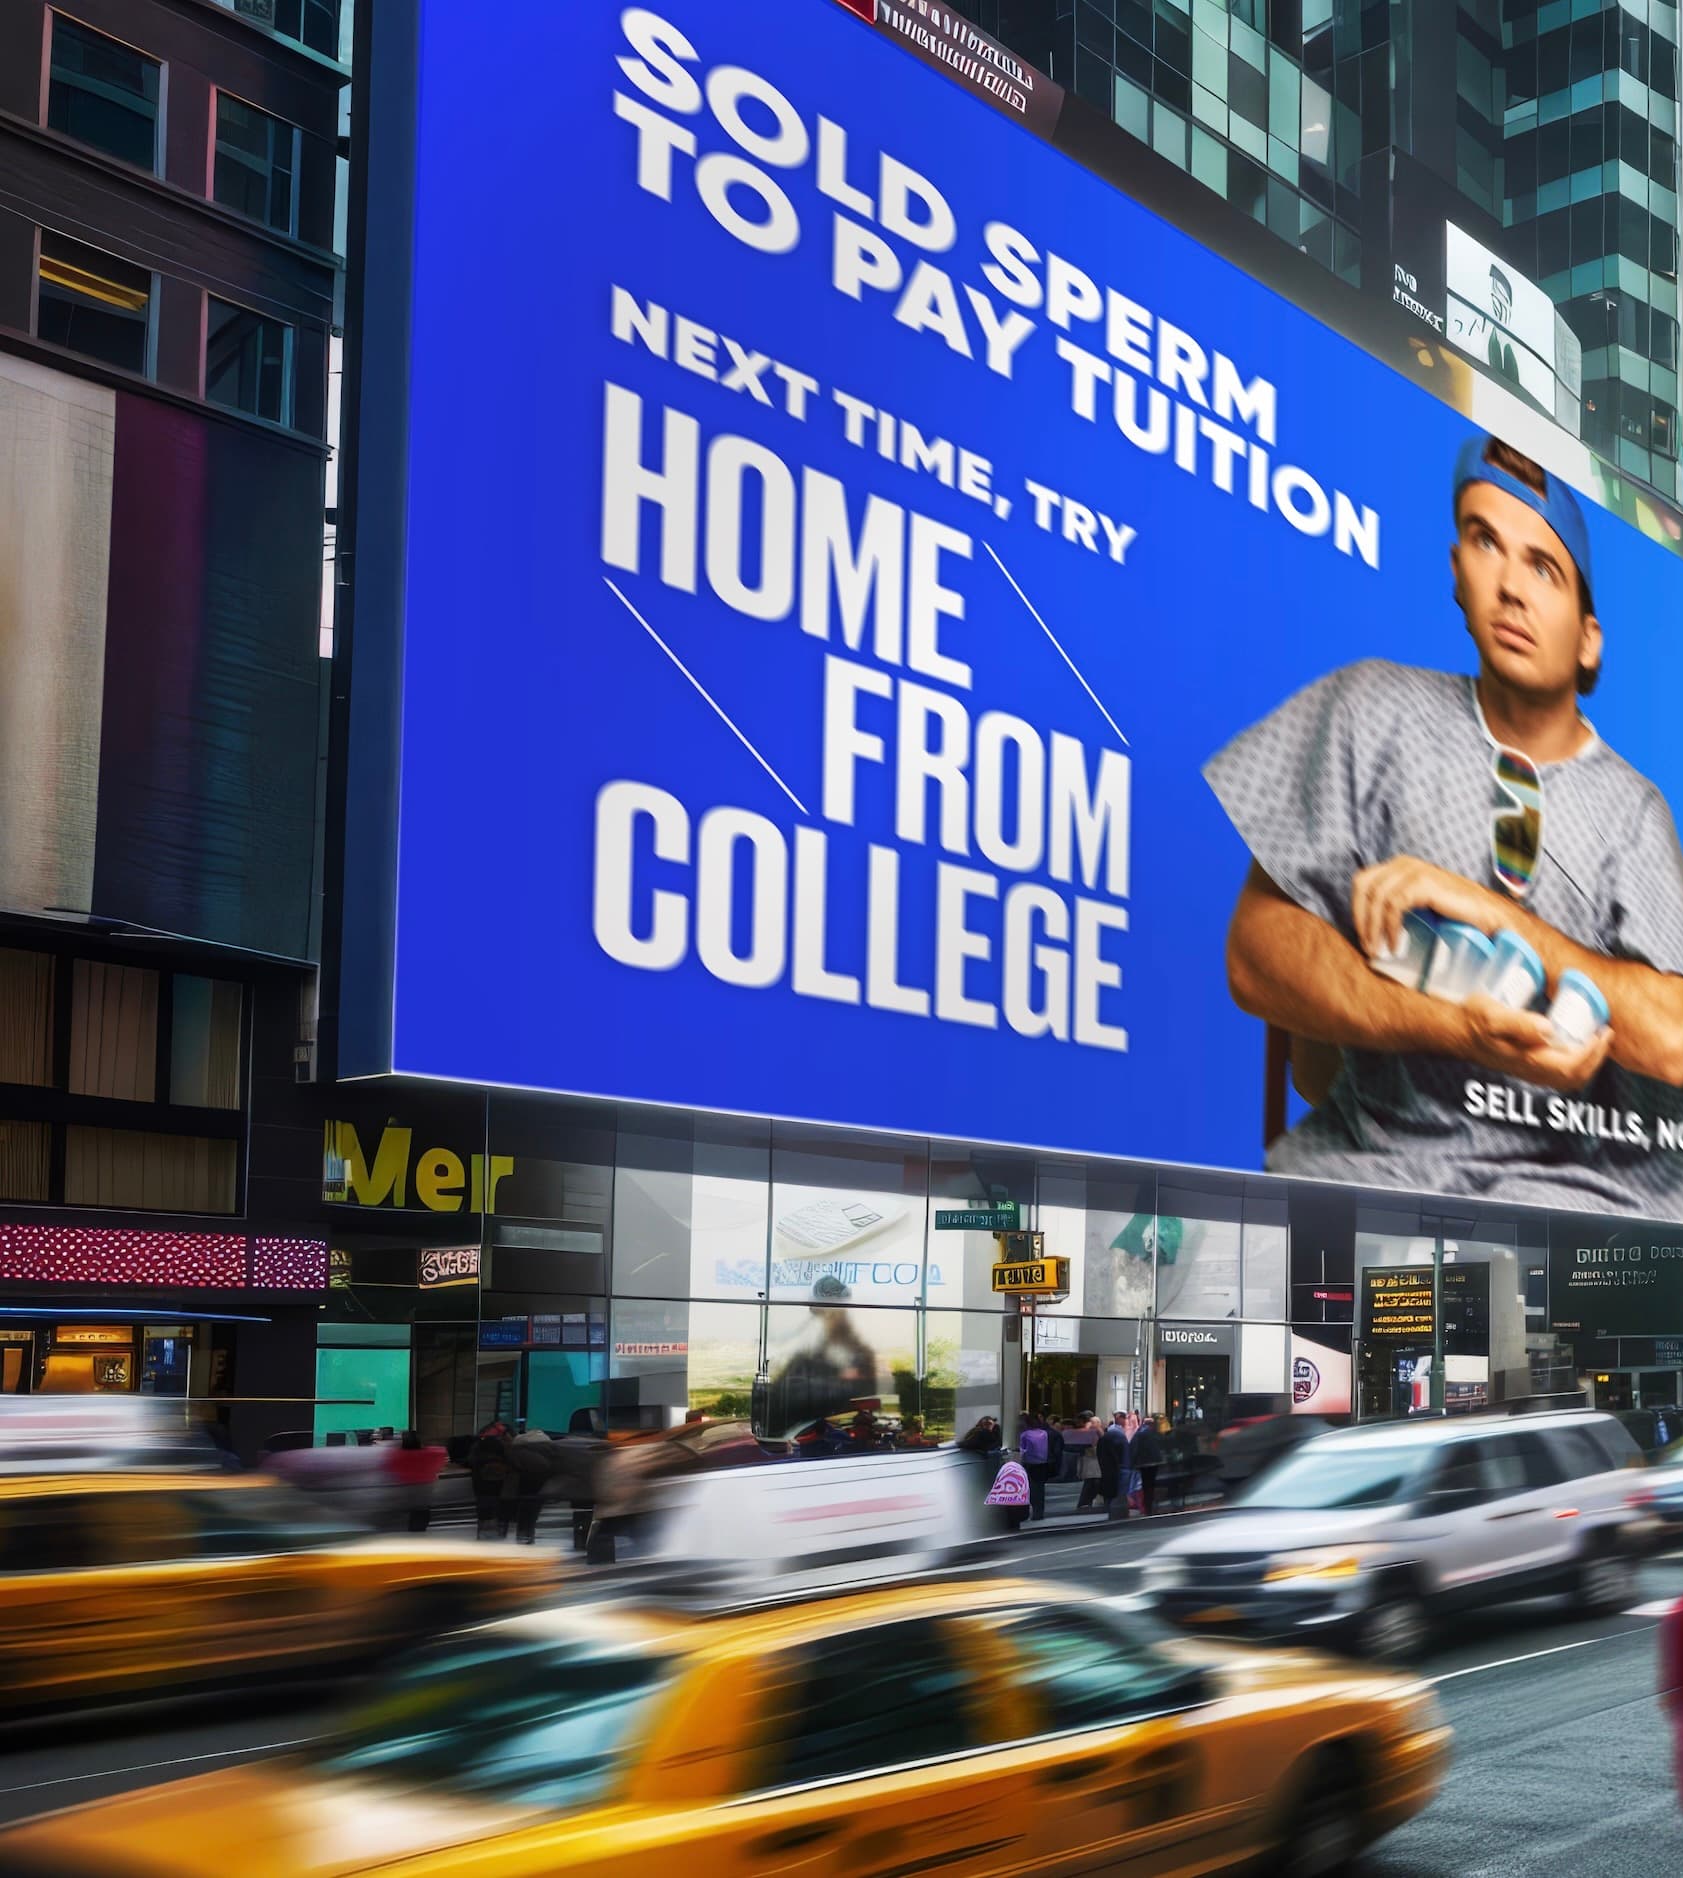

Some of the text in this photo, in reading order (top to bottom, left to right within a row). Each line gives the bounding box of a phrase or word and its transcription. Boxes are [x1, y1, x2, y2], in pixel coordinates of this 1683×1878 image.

[613, 90, 1380, 570] TO PAY TUITION
[616, 8, 957, 253] SOLD
[981, 221, 1276, 446] SPERM
[601, 380, 972, 691] HOME
[611, 284, 1137, 566] NEXT TIME, TRY
[593, 779, 1129, 1052] COLLEGE
[822, 652, 1132, 898] FROM
[1463, 1079, 1541, 1127] SELL
[1546, 1095, 1651, 1152] SKILLS,
